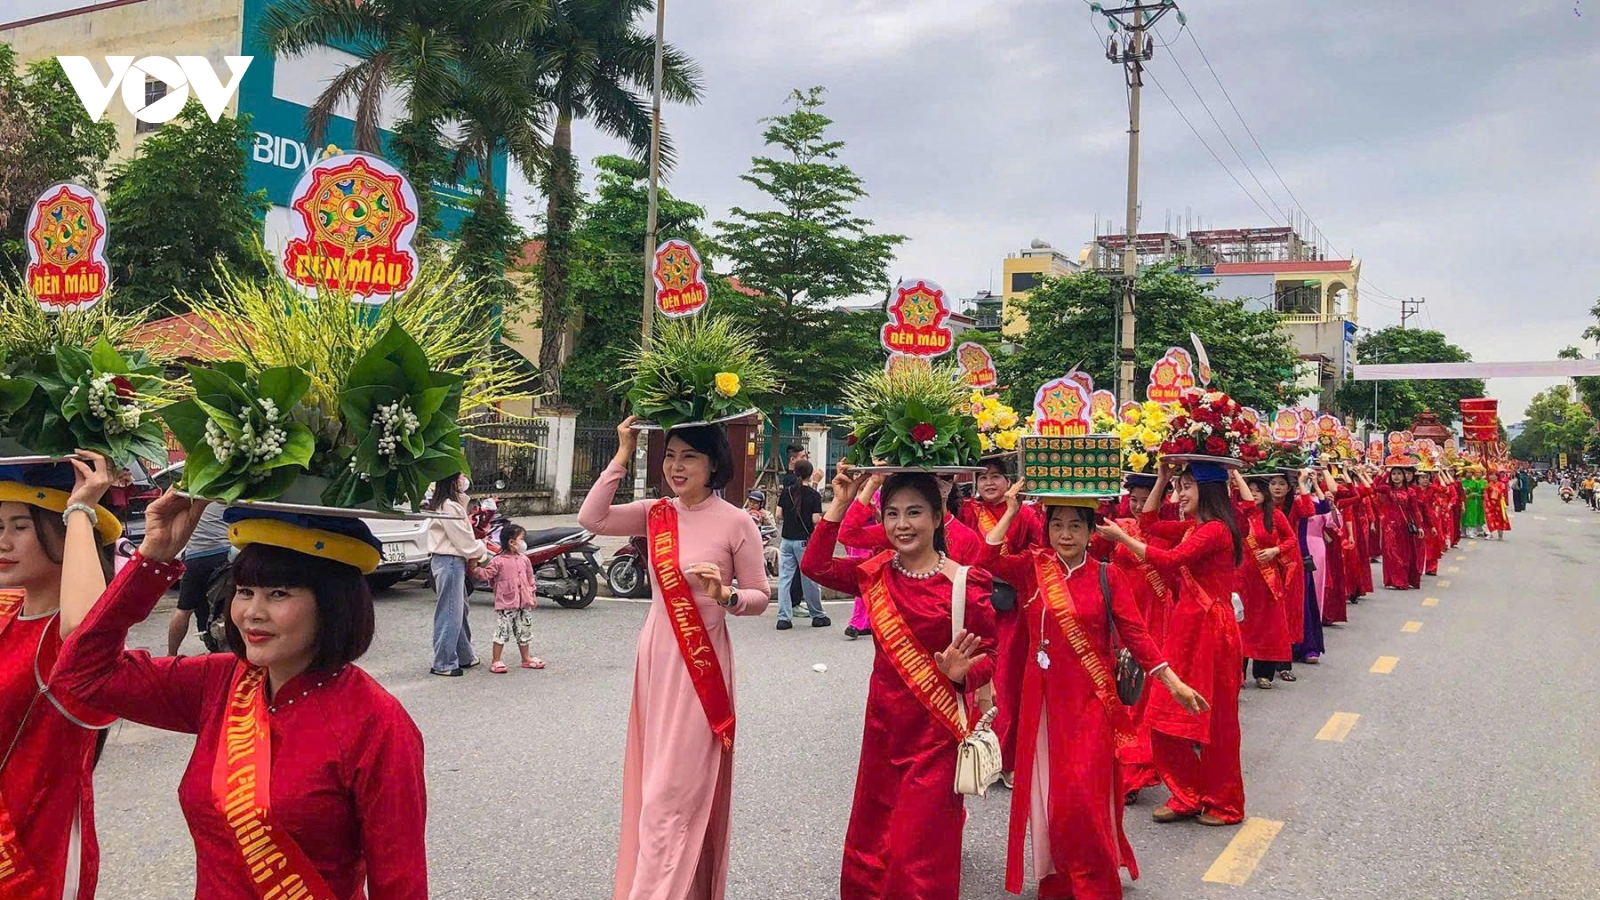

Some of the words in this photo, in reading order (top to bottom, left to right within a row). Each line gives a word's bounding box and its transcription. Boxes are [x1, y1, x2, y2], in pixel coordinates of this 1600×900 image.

[34, 267, 60, 295] ĐỀN
[64, 266, 99, 294] MẪU
[349, 254, 403, 285] MẪU
[662, 292, 680, 310] ĐỀN
[681, 287, 703, 305] MẪU
[890, 328, 914, 345] ĐỀN
[917, 331, 946, 347] MẪU
